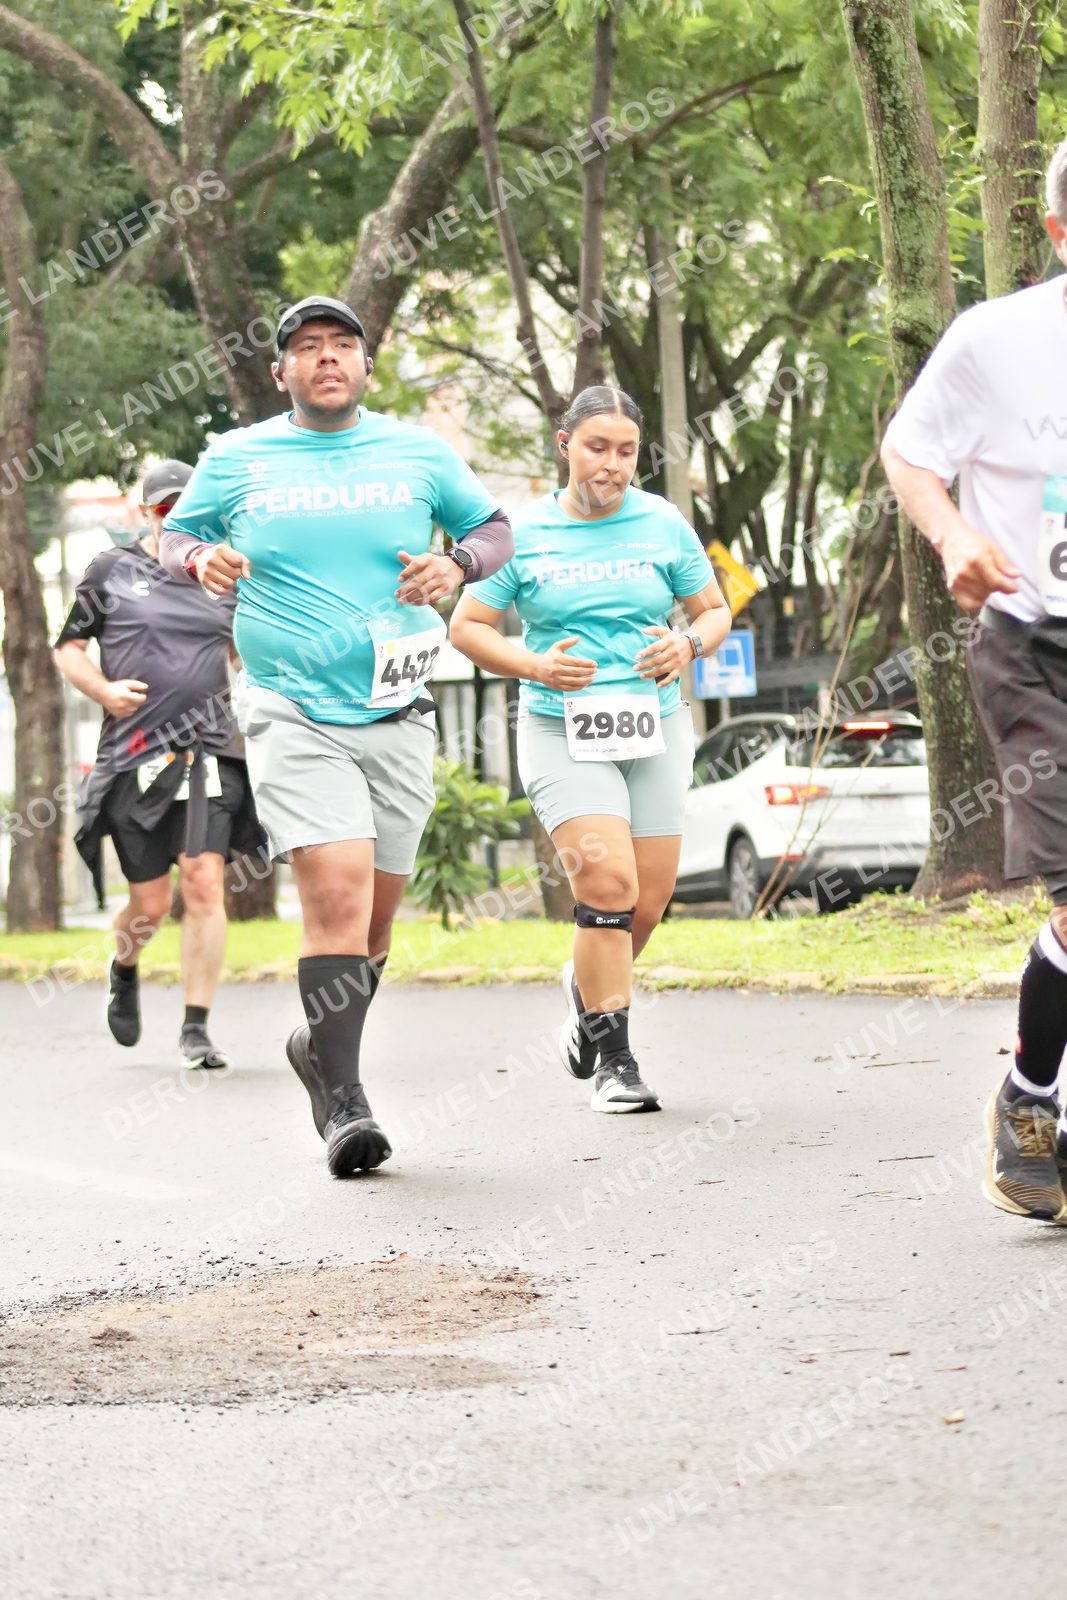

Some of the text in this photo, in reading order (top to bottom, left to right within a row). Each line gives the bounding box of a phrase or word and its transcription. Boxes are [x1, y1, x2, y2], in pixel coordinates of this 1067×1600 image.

[246, 481, 414, 515] PERDURA
[536, 559, 656, 586] PERDURA
[572, 710, 655, 740] 2980
